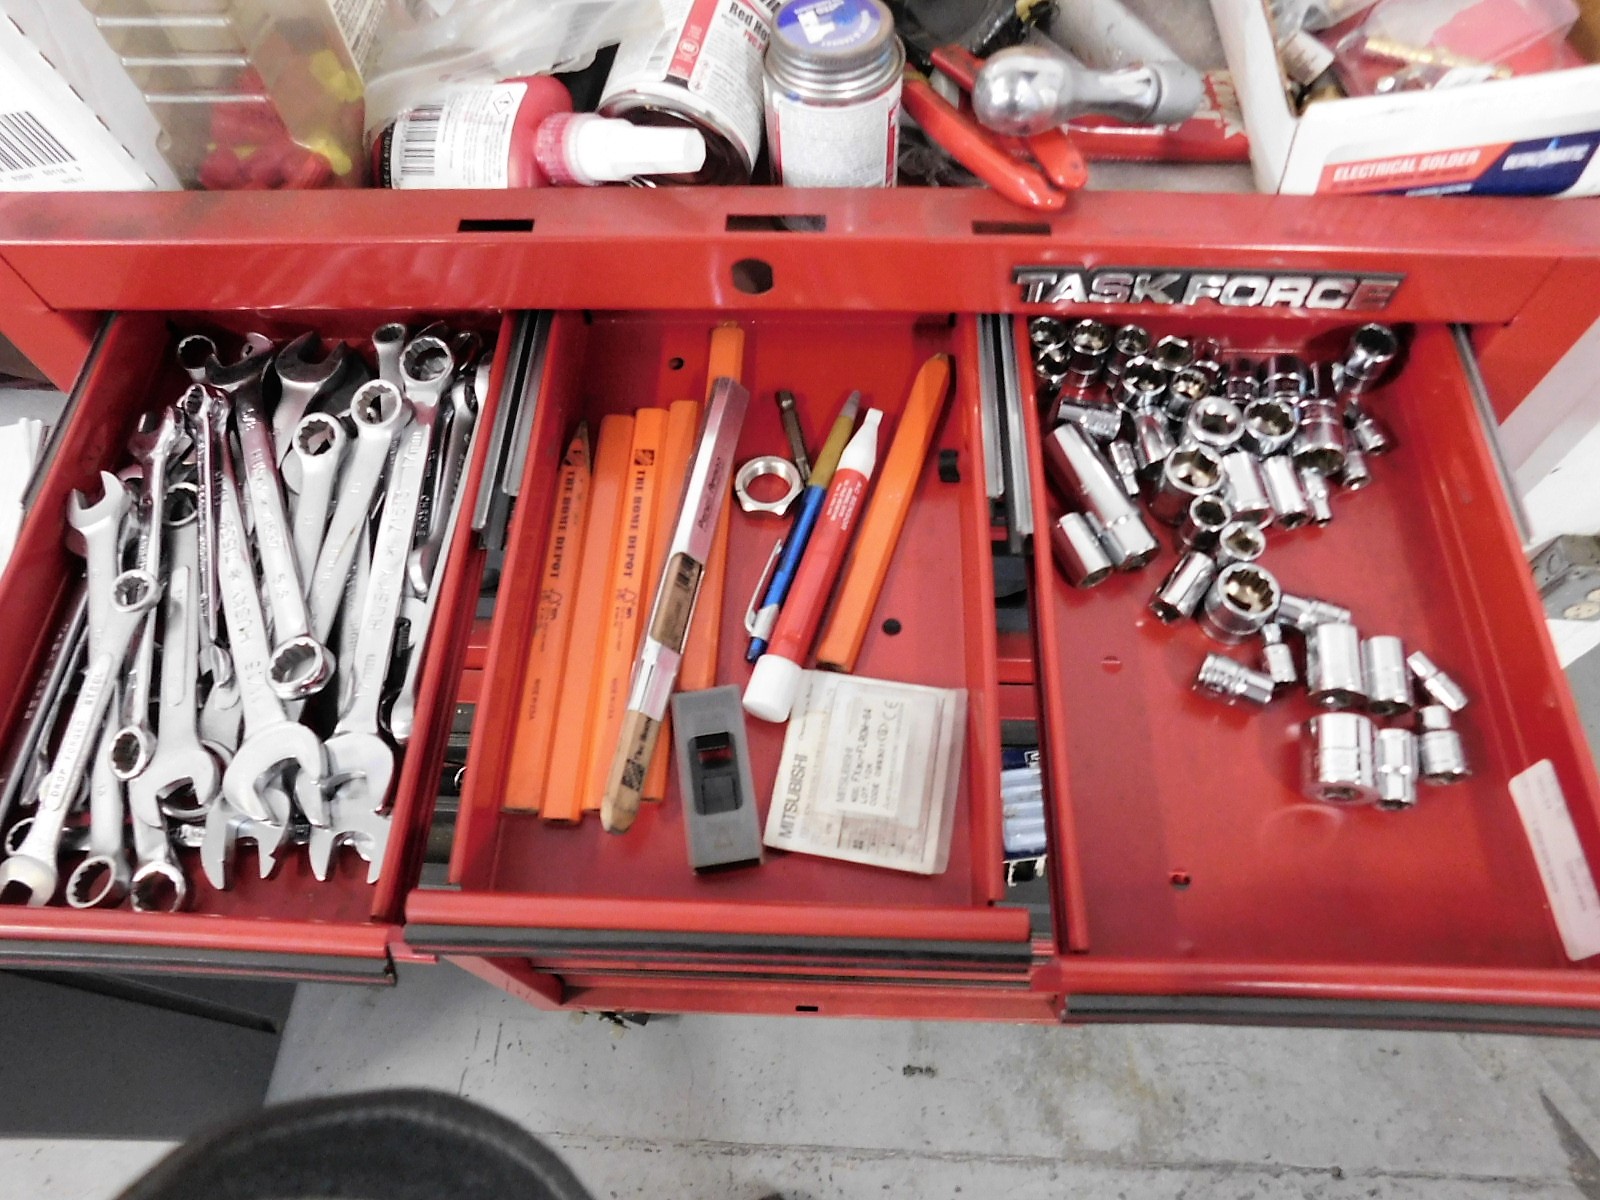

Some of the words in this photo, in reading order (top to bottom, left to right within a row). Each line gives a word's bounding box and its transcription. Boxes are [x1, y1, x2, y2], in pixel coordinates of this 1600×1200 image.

[729, 2, 754, 27] Red
[1333, 156, 1417, 181] ELECTRICAL
[1419, 149, 1481, 170] SOLDER
[1016, 271, 1181, 306] TASK
[1182, 274, 1400, 310] FORCE
[565, 471, 576, 491] THE
[635, 470, 645, 490] THE
[558, 497, 571, 530] HOME
[630, 496, 642, 529] HOME
[550, 536, 565, 577] DEPOT
[623, 536, 637, 577] DEPOT
[779, 754, 807, 840] MITSUBISHI
